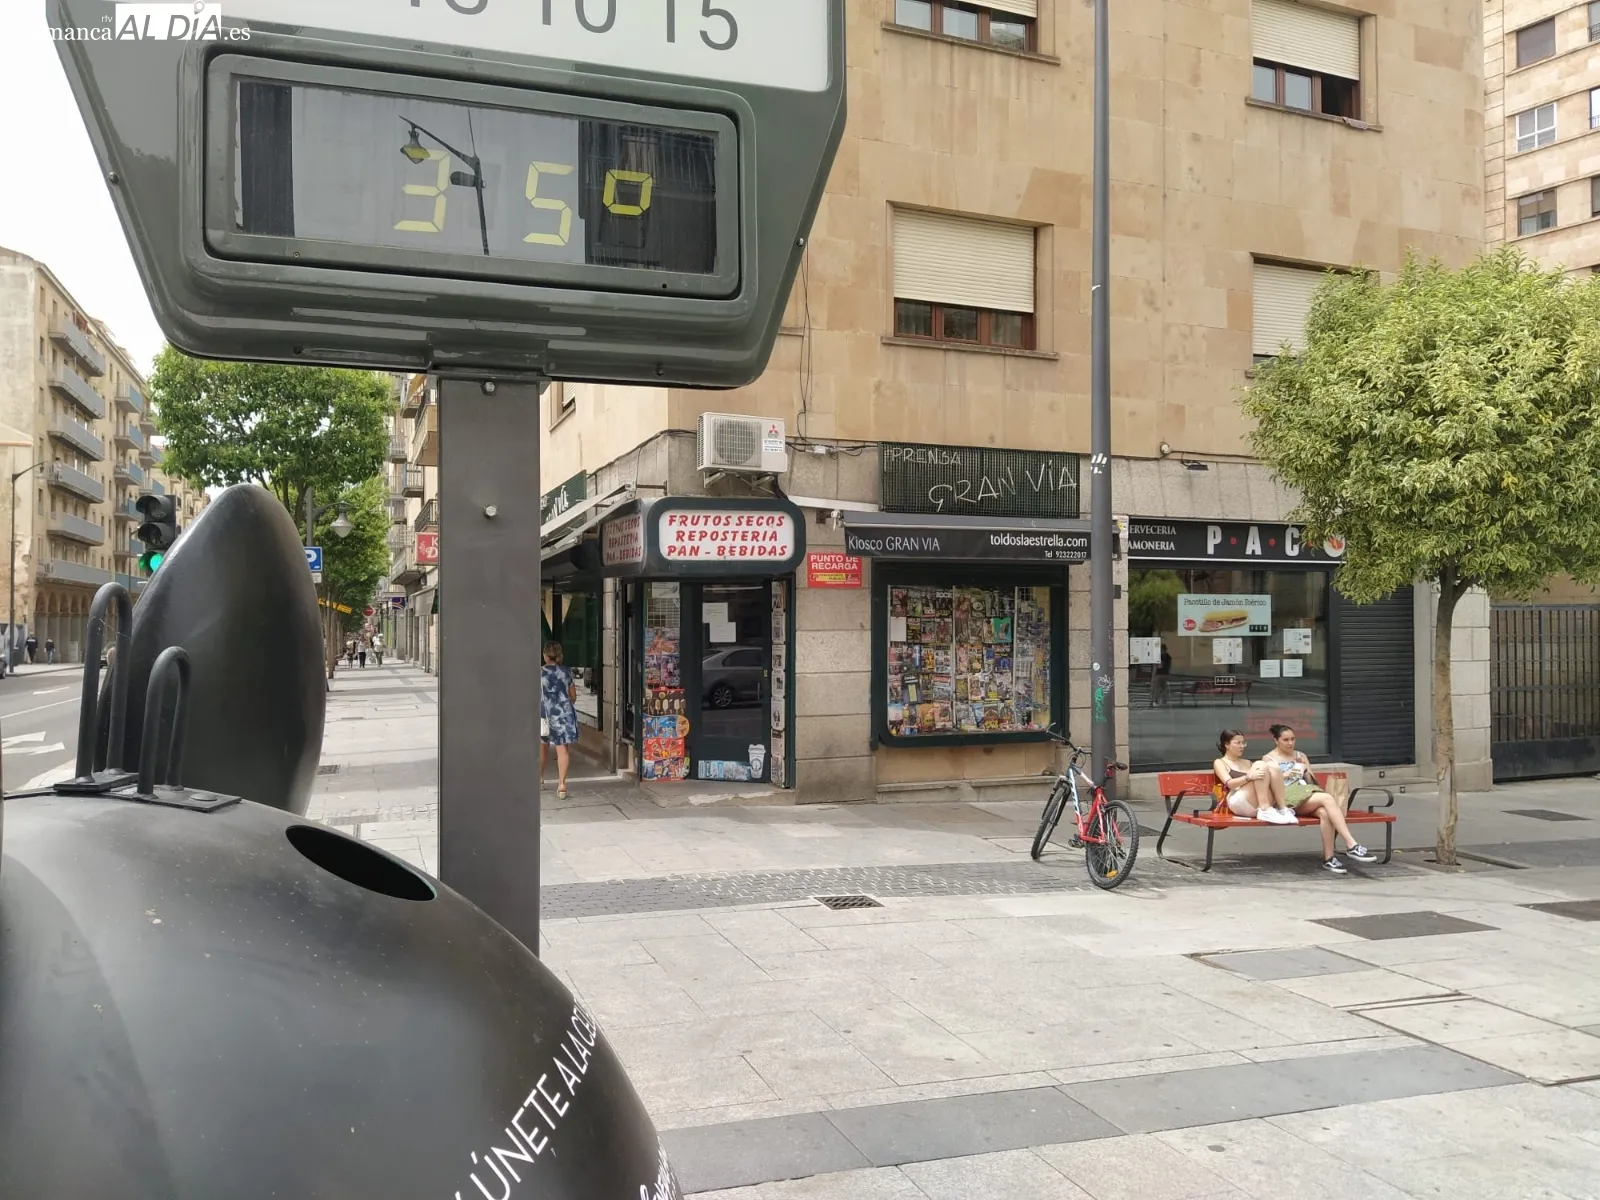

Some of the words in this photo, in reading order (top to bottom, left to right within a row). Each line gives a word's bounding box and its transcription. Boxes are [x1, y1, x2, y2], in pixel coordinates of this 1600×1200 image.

[891, 447, 962, 465] PRENSA
[928, 466, 1016, 512] GRAN
[668, 514, 732, 527] FRUTOS
[735, 515, 785, 527] SECOS
[1129, 524, 1177, 535] ERVECERIA
[675, 530, 778, 542] REPOSTERIA
[990, 532, 1088, 548] toldoslaestrella.com
[848, 535, 883, 550] Kiosco
[885, 536, 919, 551] GRAN
[921, 537, 941, 551] VIA
[1128, 540, 1176, 551] AMONERIA
[666, 545, 700, 557] PAN
[716, 545, 788, 557] BEBIDAS
[810, 554, 844, 563] PUNTO
[811, 562, 858, 570] RECARGA
